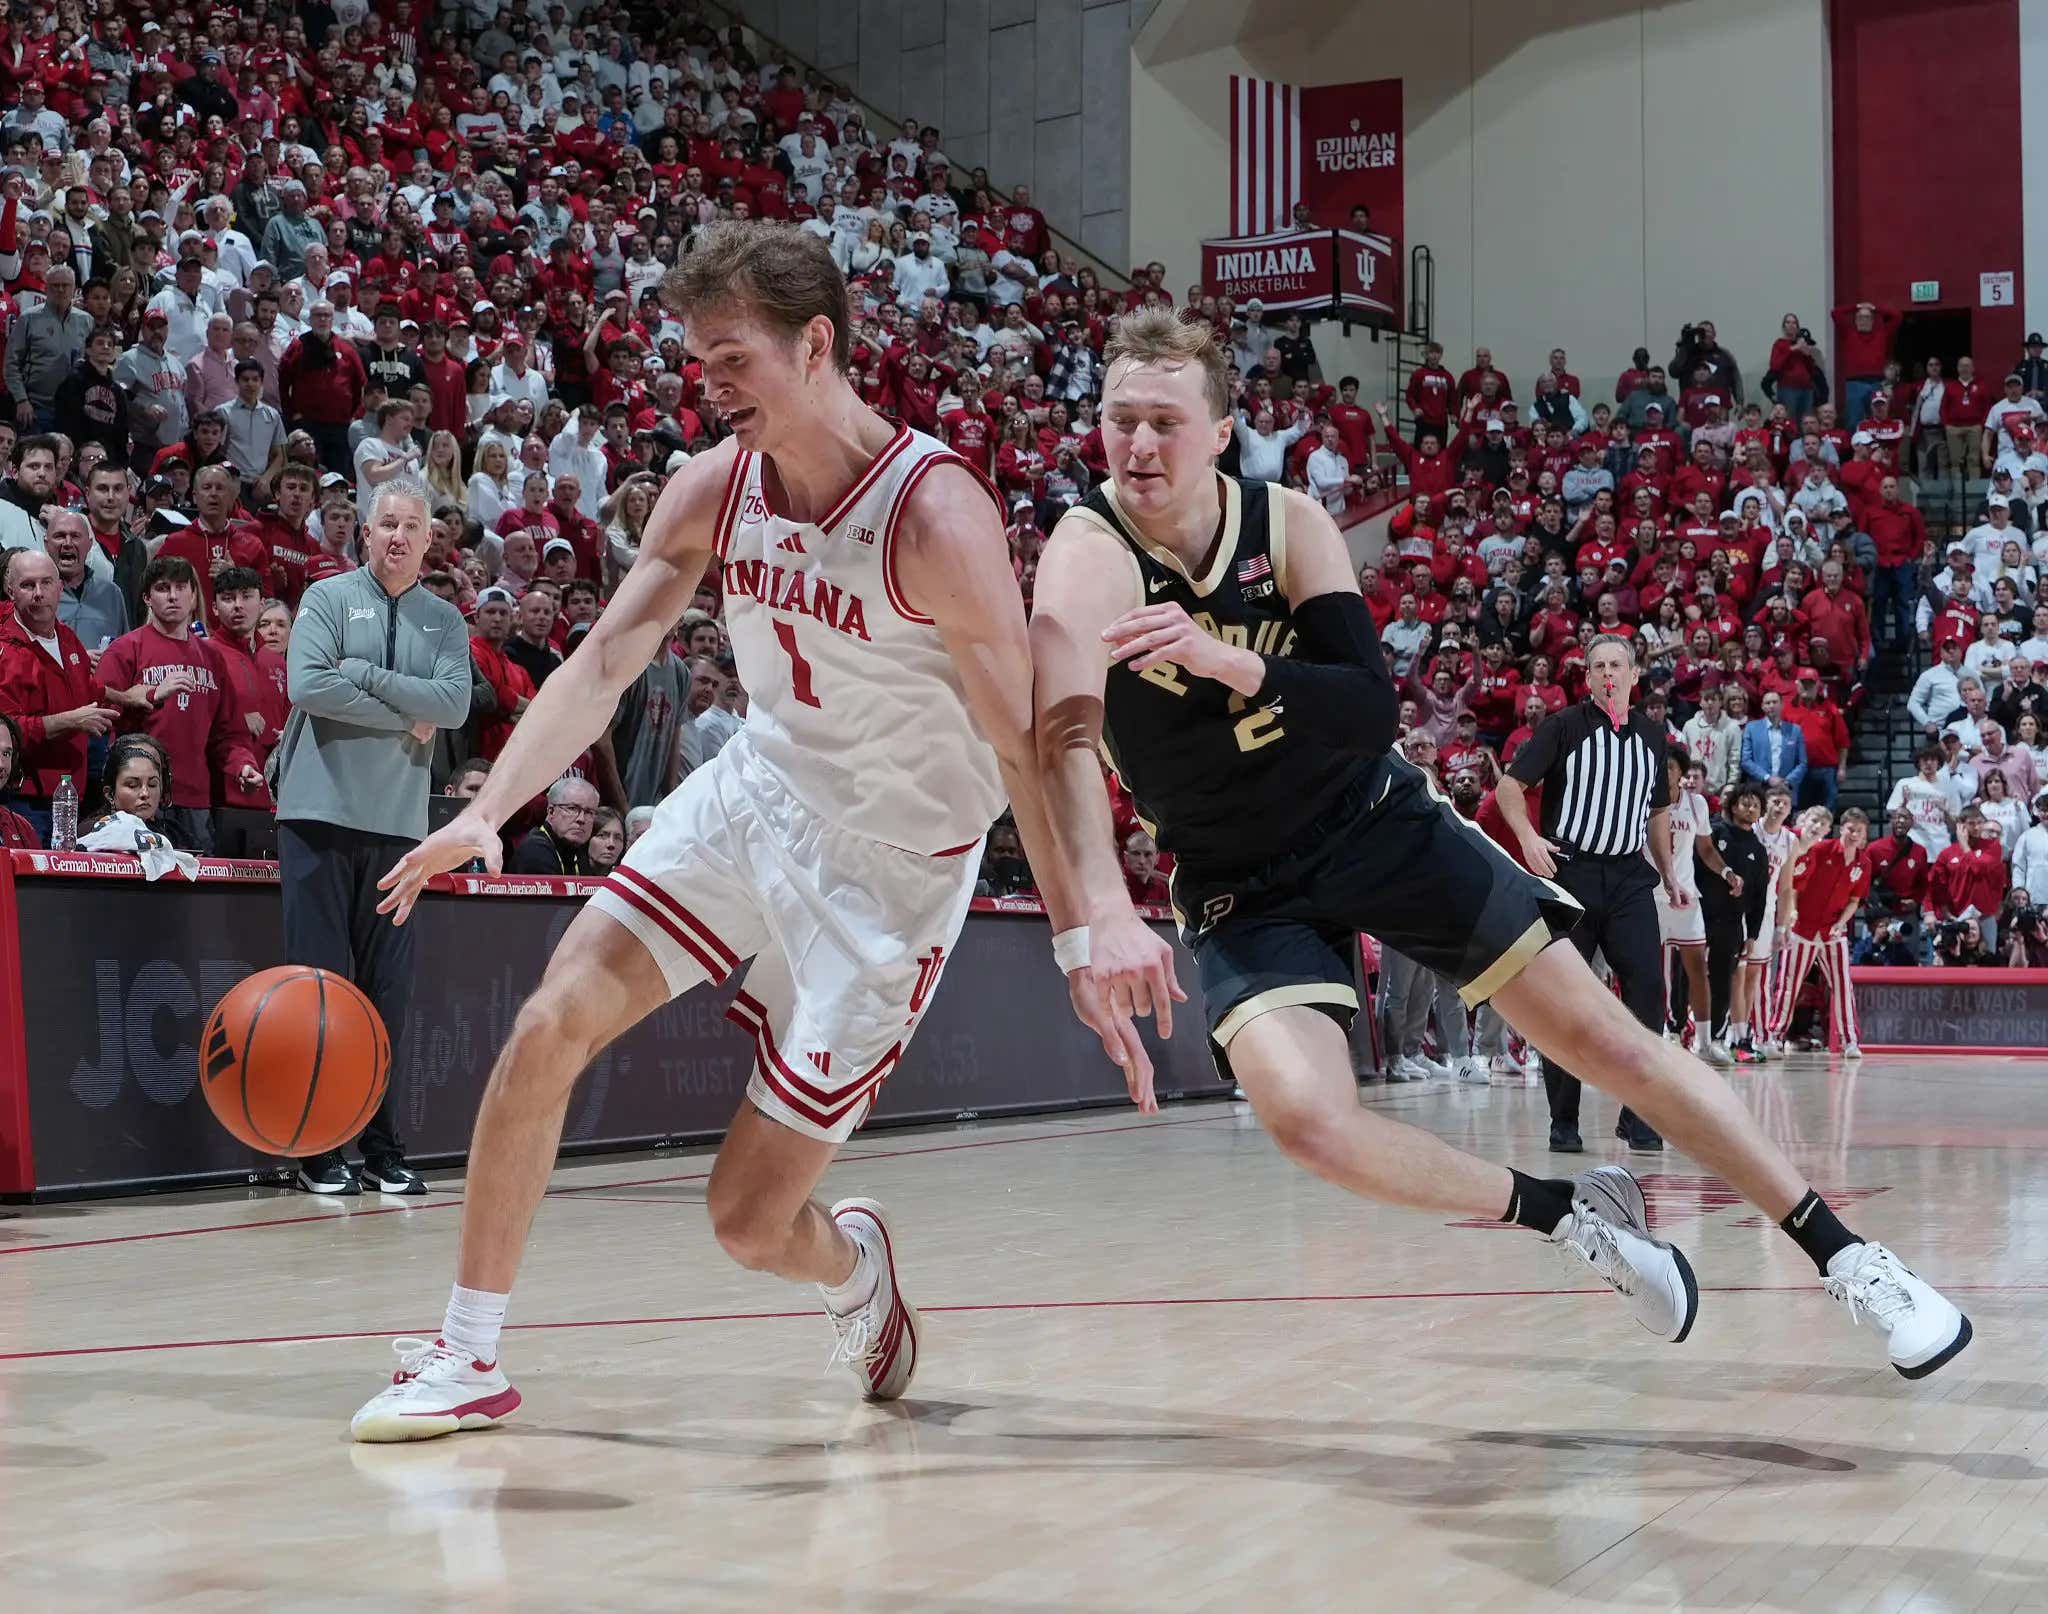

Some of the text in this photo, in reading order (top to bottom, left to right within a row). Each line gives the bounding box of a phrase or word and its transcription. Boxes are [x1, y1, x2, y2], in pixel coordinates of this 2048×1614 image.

[1344, 132, 1396, 153] IMAN
[1317, 149, 1396, 172] TUCKER
[1216, 246, 1316, 281] INDIANA
[1225, 276, 1307, 296] BASKETBALL
[1992, 284, 2002, 302] 5
[745, 495, 763, 515] 76
[772, 617, 822, 709] 1
[50, 855, 89, 872] German
[90, 858, 132, 875] American
[229, 864, 266, 879] American
[480, 880, 507, 894] German
[508, 881, 537, 895] American
[1199, 893, 1235, 935] P
[1854, 986, 2028, 1012] HOOSIERS ALWAYS
[1858, 1015, 1905, 1041] AME
[1911, 1015, 1945, 1041] DAY
[660, 1056, 733, 1096] TRUST
